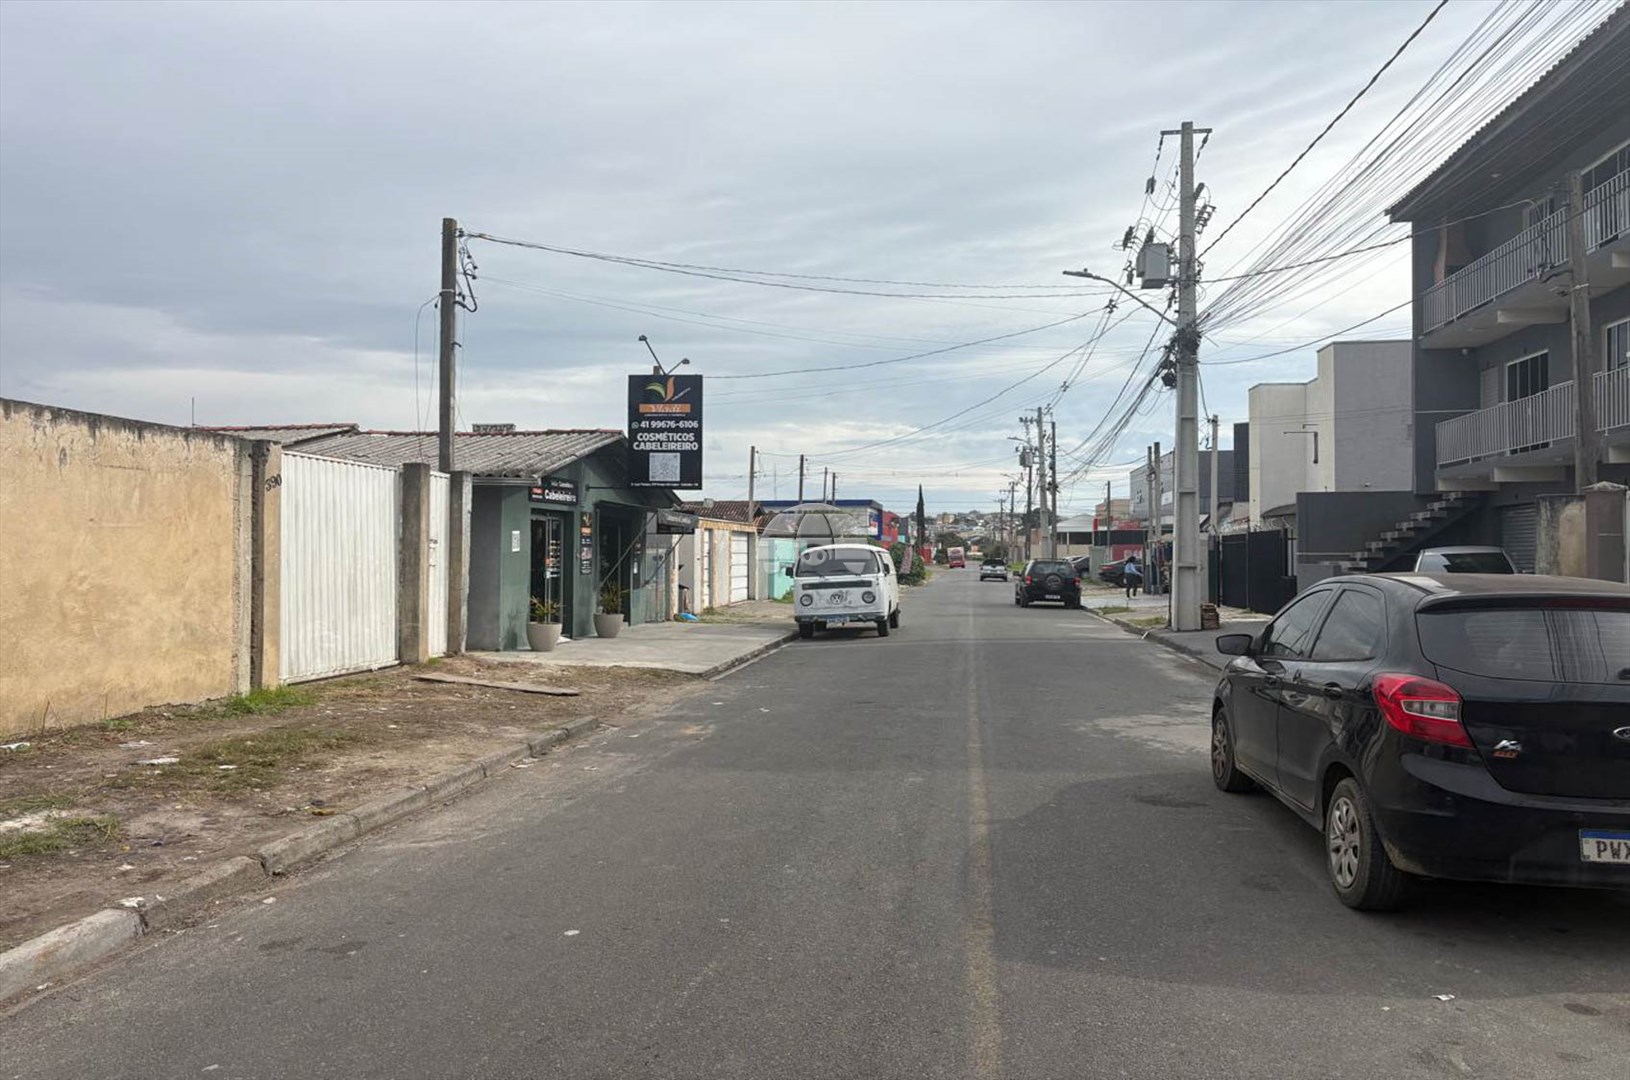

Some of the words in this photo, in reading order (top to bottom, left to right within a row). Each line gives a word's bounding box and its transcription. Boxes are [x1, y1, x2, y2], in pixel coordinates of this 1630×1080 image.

[640, 420, 649, 428] 41
[650, 420, 699, 428] 99676-6106
[637, 431, 695, 441] COSMÉTICOS
[633, 442, 699, 451] CABELEIREIRO
